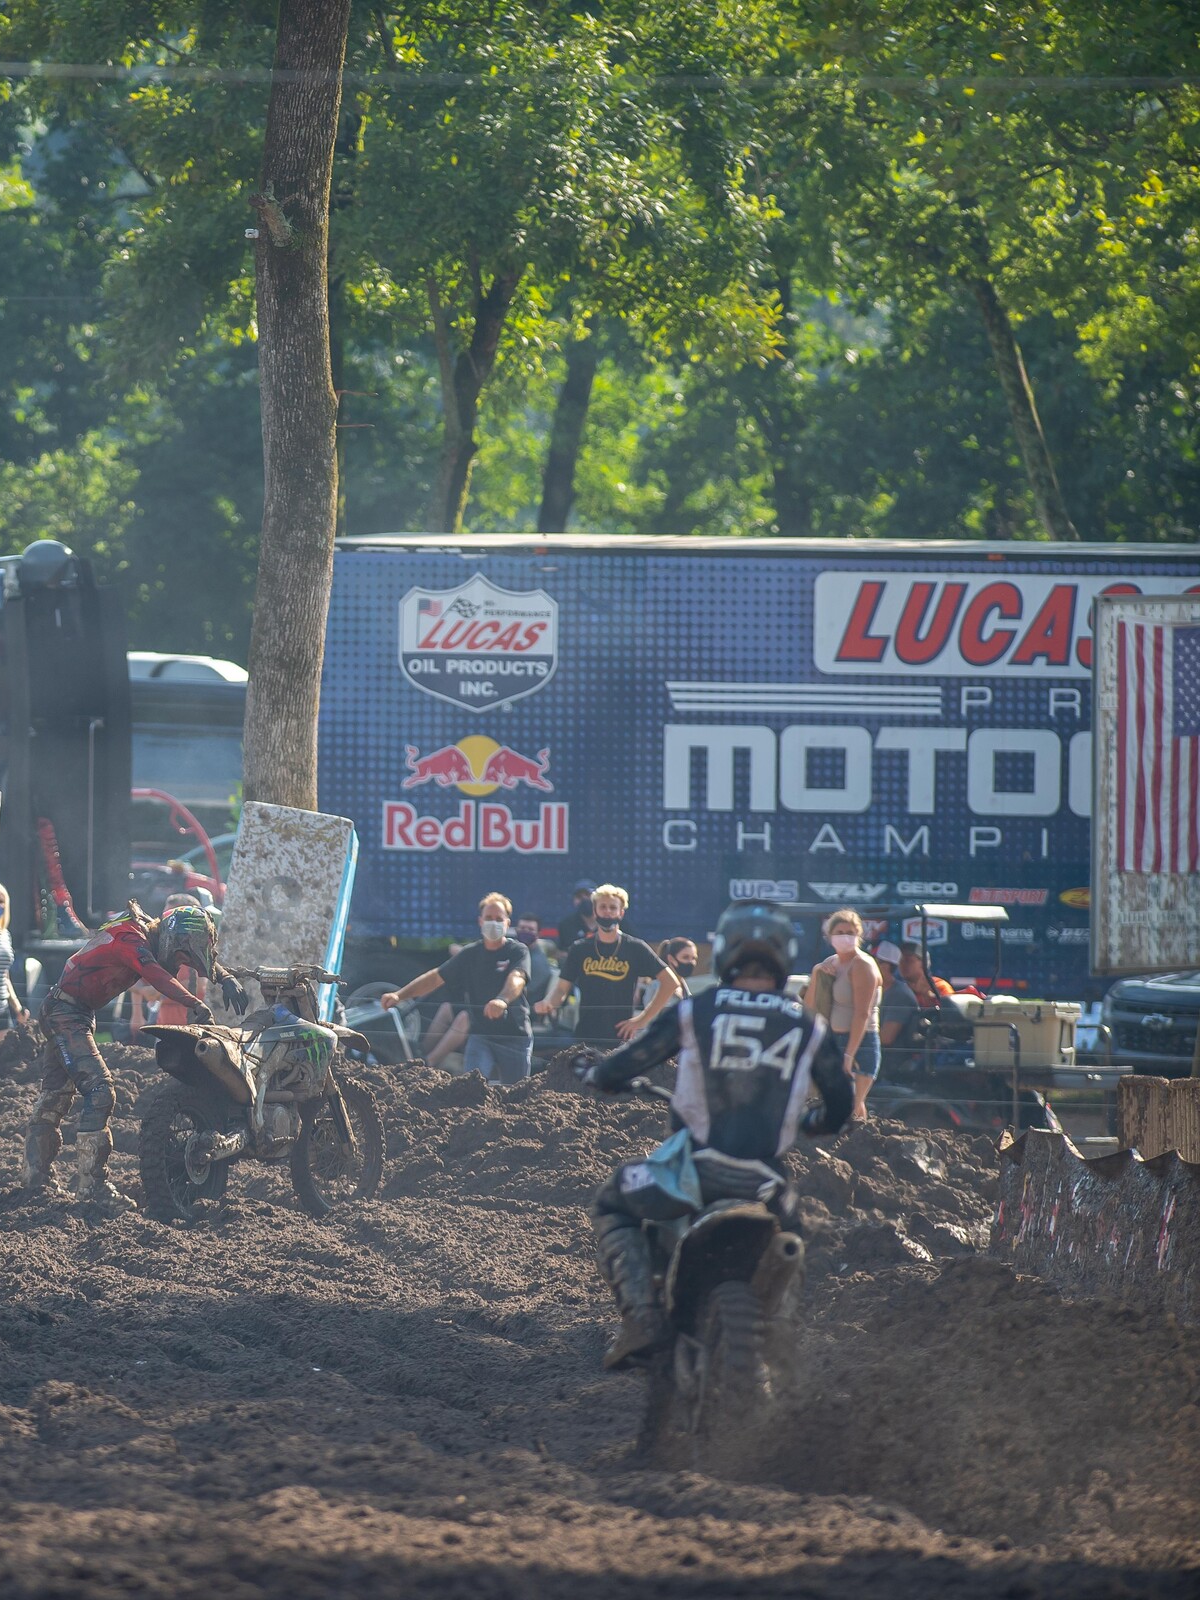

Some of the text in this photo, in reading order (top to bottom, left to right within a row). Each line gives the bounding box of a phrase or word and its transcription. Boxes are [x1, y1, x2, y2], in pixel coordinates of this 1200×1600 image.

[417, 619, 549, 651] LUCAS
[834, 579, 1142, 667] LUCA
[407, 658, 549, 677] OIL PRODUCTS
[458, 680, 499, 697] INC.
[663, 723, 1092, 817] MOTO
[382, 800, 570, 854] Red Bull
[662, 819, 1049, 859] CHAMPI
[729, 878, 800, 901] WPS
[896, 881, 959, 897] GEICO
[975, 924, 1034, 939] Husvarna
[582, 956, 630, 977] Goldies
[709, 1013, 804, 1081] 154
